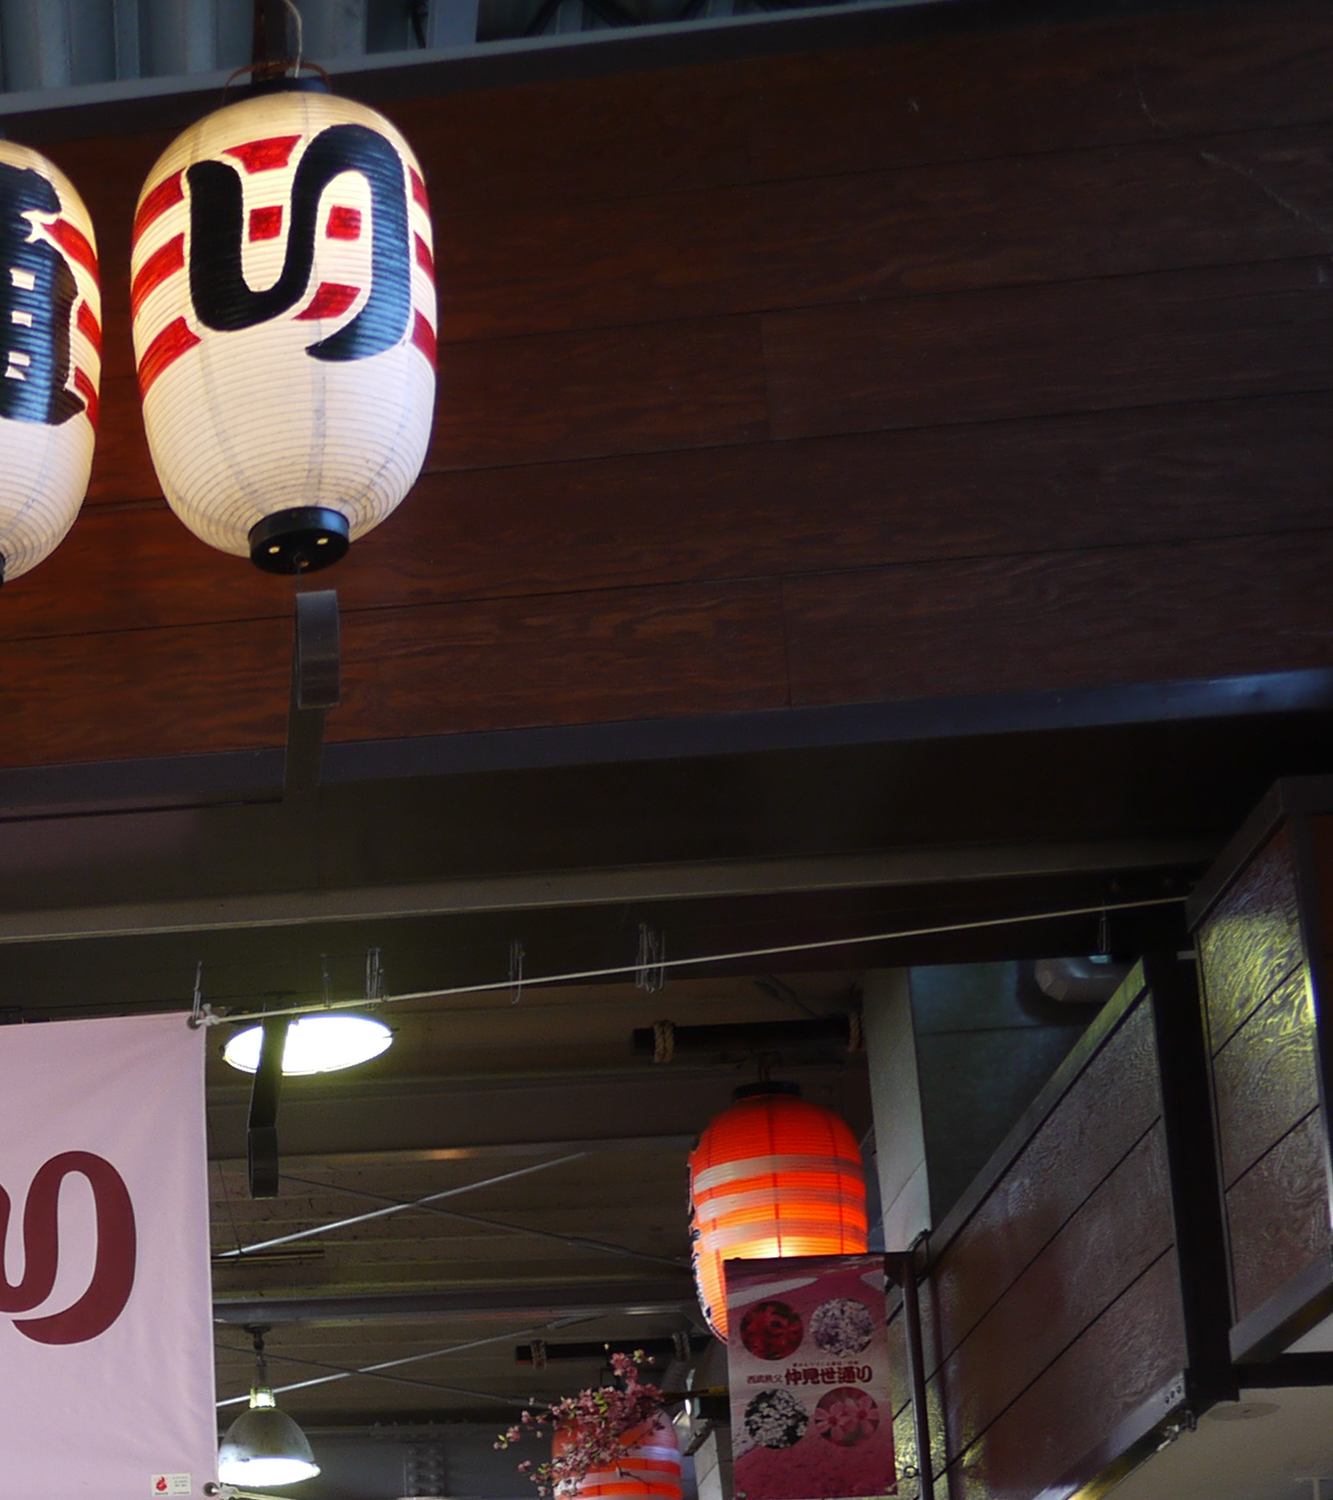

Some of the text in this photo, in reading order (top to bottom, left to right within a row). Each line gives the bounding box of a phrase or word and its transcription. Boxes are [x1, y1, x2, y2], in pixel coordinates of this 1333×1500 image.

[784, 1365, 873, 1386] 仲見世通り
